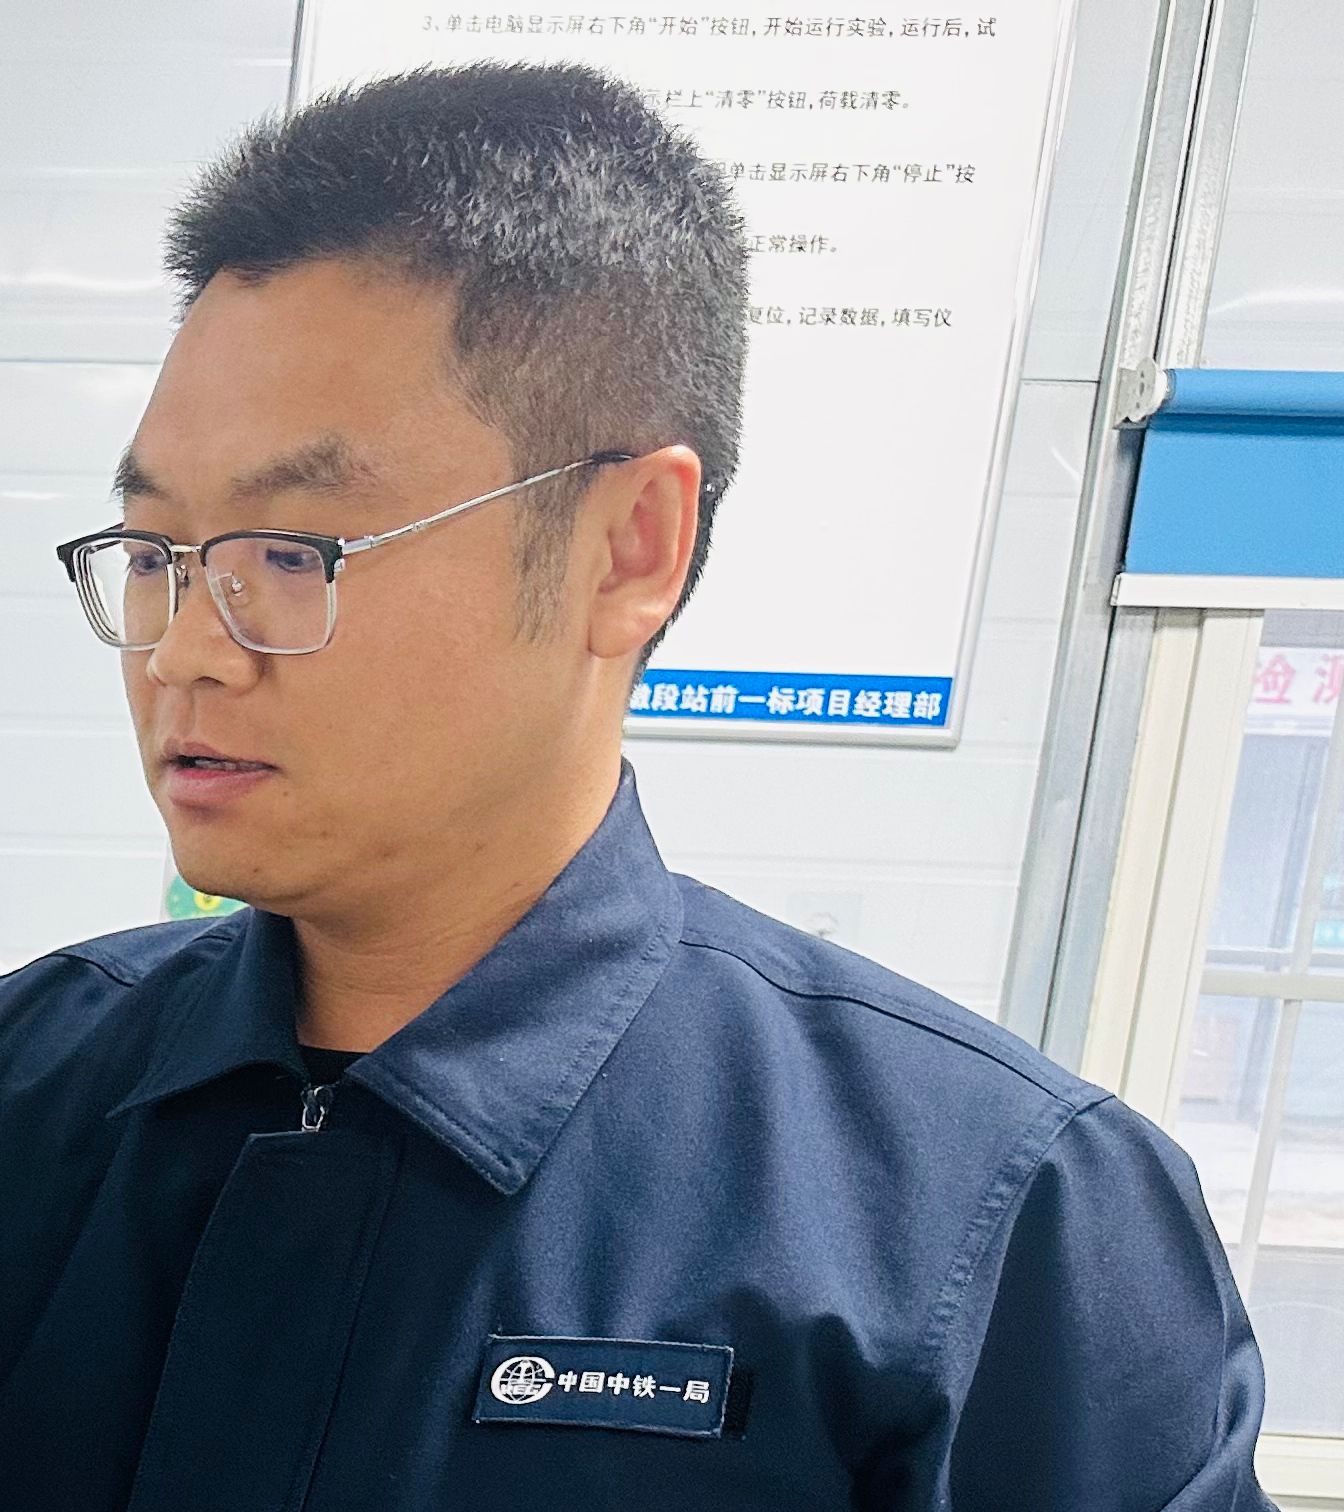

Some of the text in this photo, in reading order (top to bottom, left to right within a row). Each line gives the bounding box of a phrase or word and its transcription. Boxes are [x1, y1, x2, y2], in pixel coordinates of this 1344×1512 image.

[558, 1371, 711, 1404] 中国中铁一局
